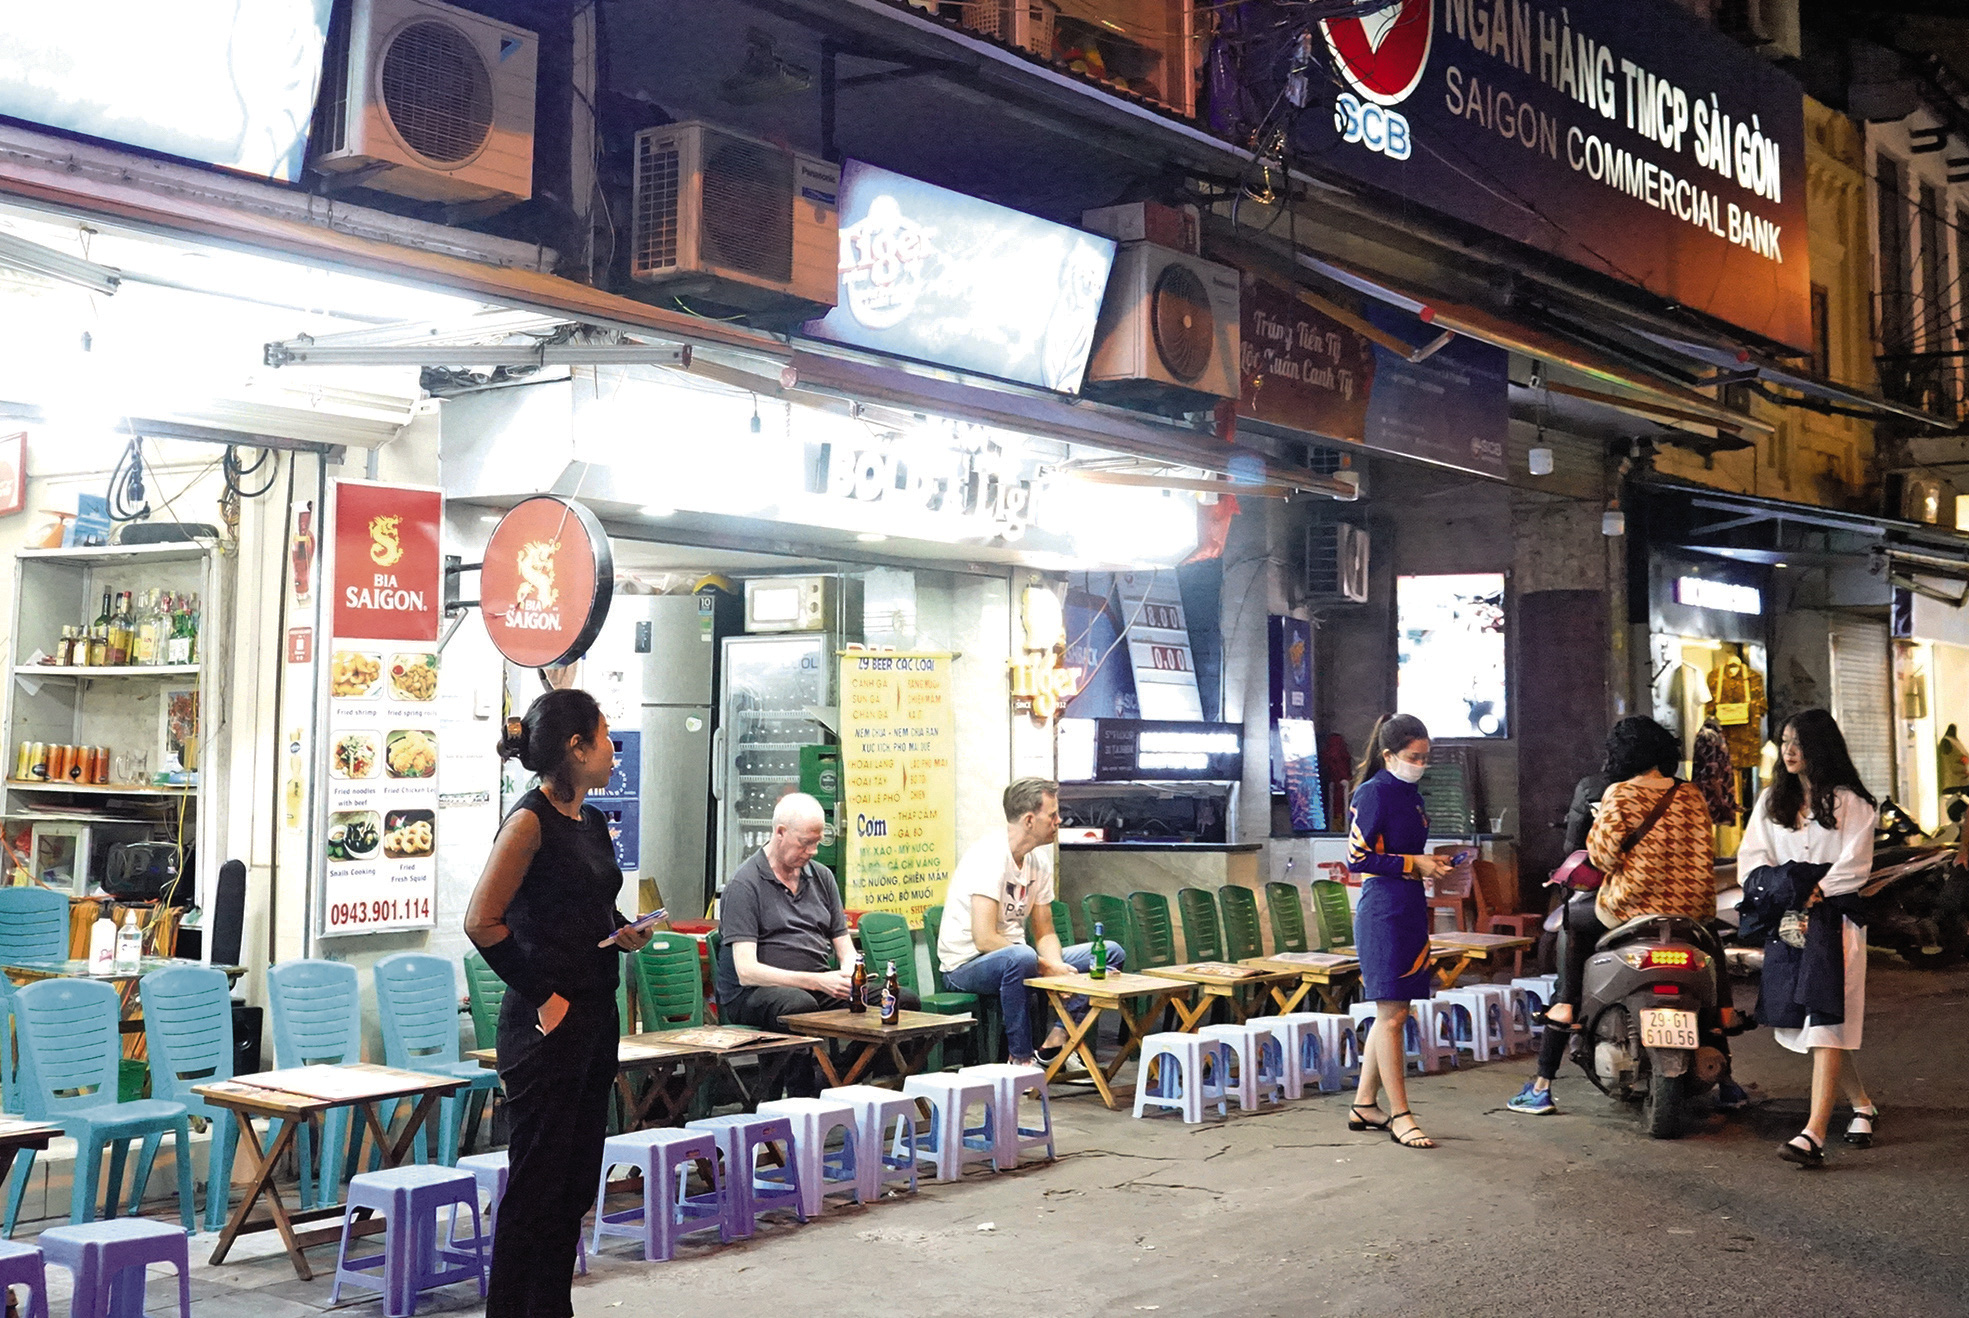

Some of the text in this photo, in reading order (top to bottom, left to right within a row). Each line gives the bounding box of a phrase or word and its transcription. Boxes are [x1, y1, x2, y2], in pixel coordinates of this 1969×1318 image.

[1334, 92, 1412, 160] SCB
[1621, 57, 1688, 153] TMCP
[1694, 91, 1732, 179] SÀI
[1734, 113, 1782, 204] GÒN
[1445, 65, 1783, 264] SAIGON COMMERCIAL BANK
[802, 165, 837, 184] Panasonic
[1303, 358, 1335, 390] Canh
[374, 573, 398, 588] BIA
[525, 600, 543, 611] BIA
[701, 598, 711, 606] 10
[872, 657, 893, 671] BEER
[1154, 647, 1186, 671] 0.00
[1008, 650, 1083, 718] Tiger
[336, 708, 377, 717] Fried shrimp
[857, 812, 887, 838] Cơm
[330, 868, 376, 877] Snails Cooking
[331, 897, 430, 926] 0943.901.114
[1650, 1012, 1689, 1028] 29-G1
[1646, 1029, 1695, 1046] 610.56
